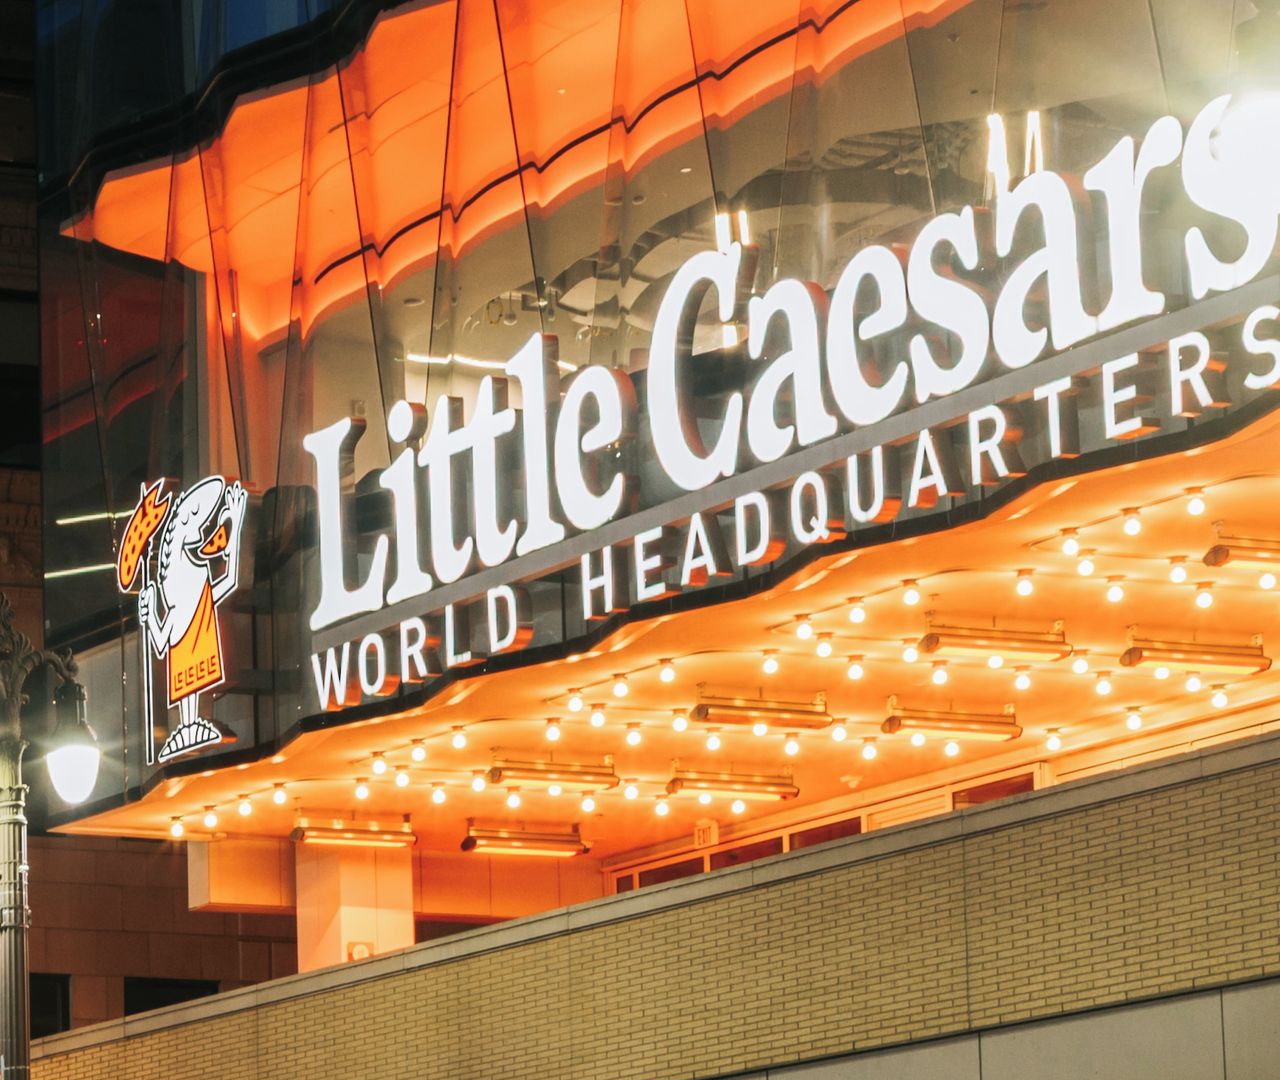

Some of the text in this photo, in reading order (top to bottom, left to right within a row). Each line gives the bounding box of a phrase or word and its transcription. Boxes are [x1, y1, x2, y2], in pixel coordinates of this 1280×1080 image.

[303, 93, 1280, 631] Little Caesars
[310, 304, 1280, 711] WORLD HEADQUARTERS
